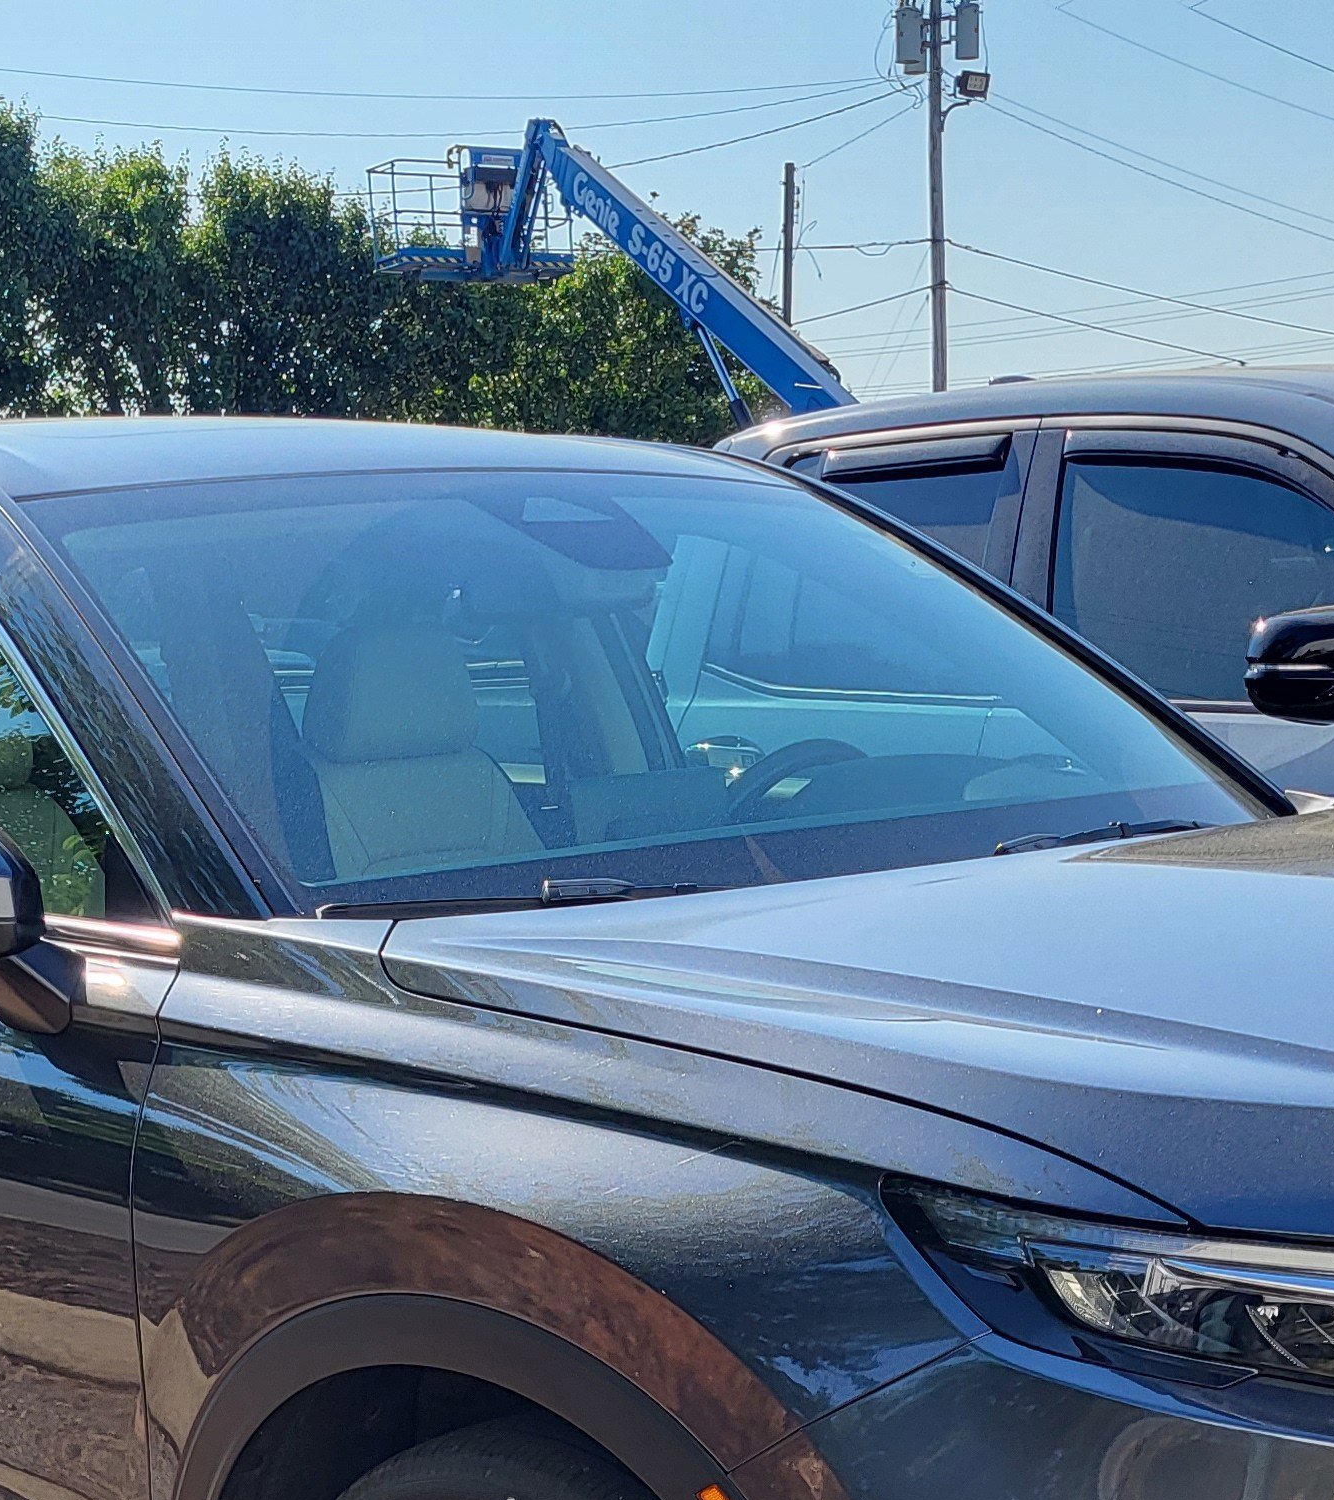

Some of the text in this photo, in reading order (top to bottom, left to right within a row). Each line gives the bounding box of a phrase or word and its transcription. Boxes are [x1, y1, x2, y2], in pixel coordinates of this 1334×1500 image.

[574, 171, 709, 314] Genie S-65 XC
